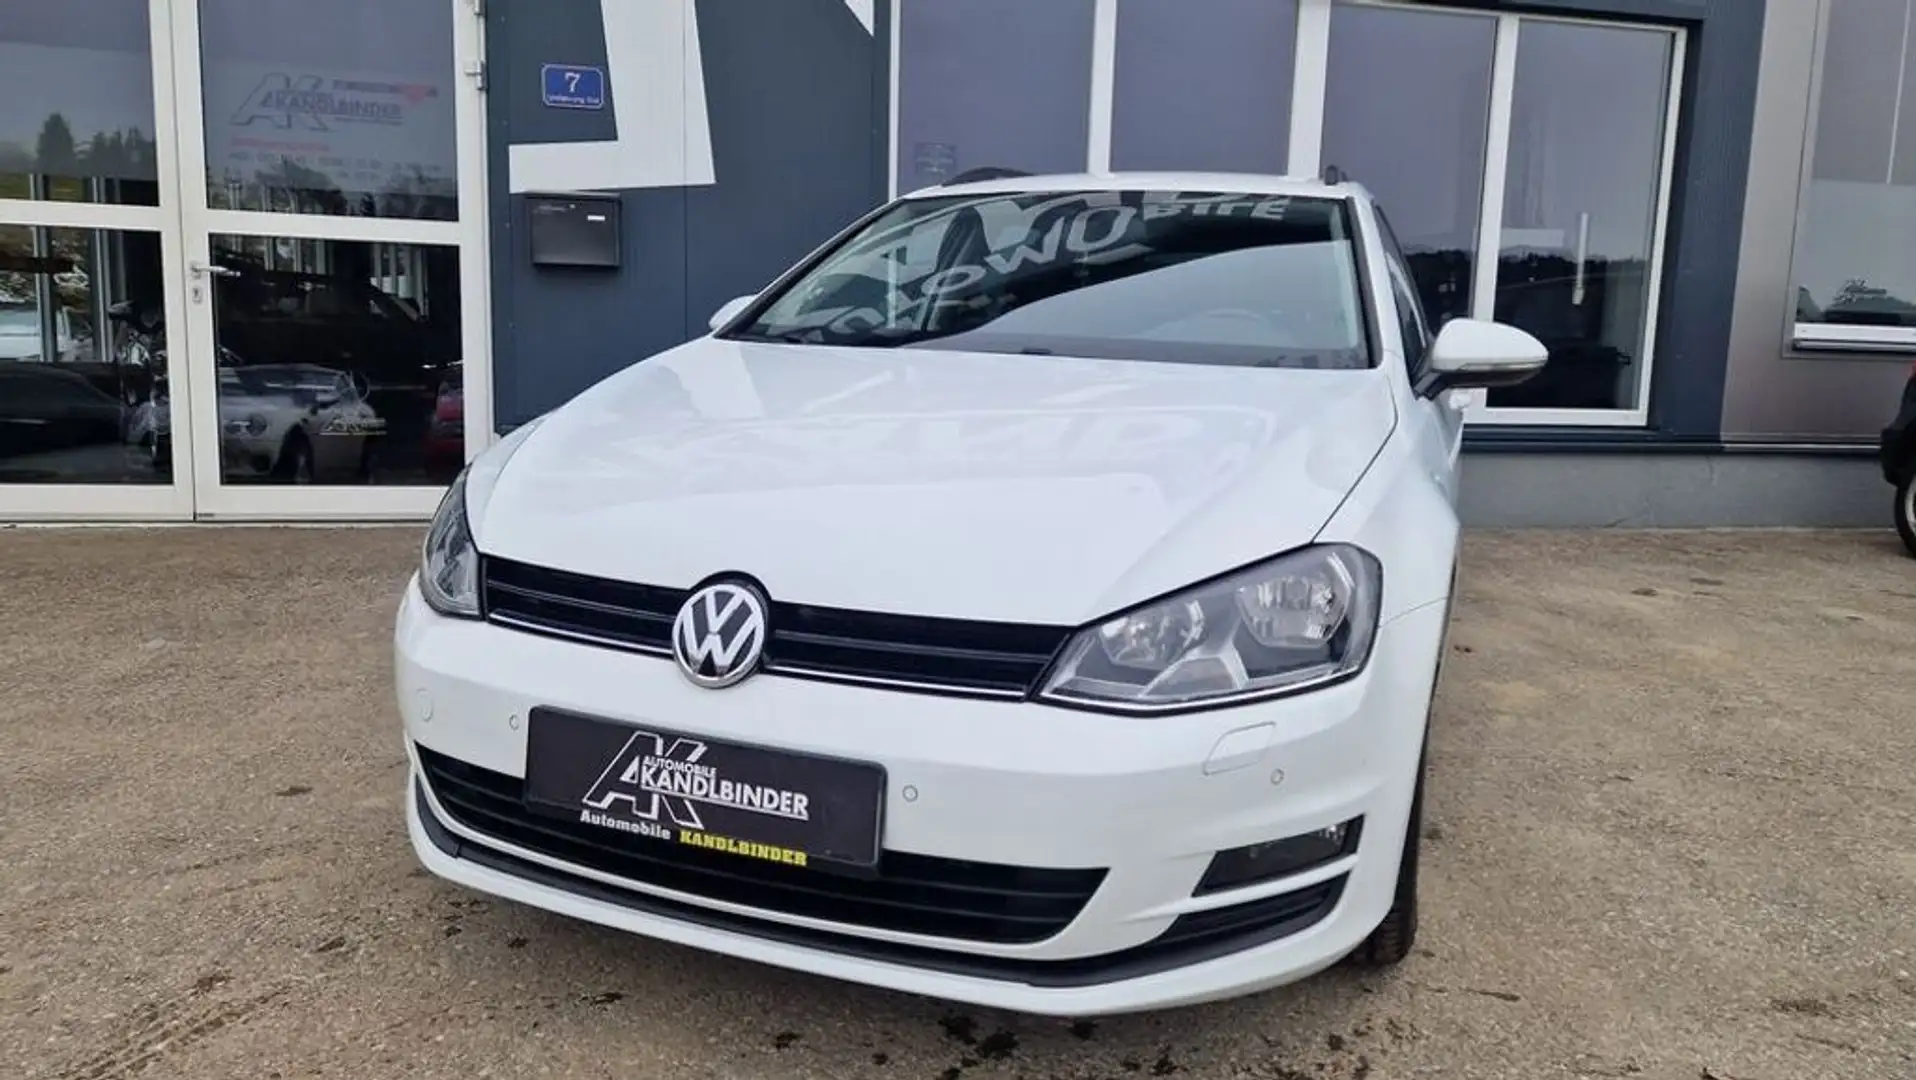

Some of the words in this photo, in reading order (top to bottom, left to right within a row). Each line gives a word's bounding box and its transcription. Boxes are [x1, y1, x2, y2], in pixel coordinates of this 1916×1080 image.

[564, 71, 581, 93] 7
[675, 585, 762, 681] VW
[641, 764, 809, 818] KANDLBINDER
[642, 755, 716, 779] AUTOMOBILE
[580, 809, 671, 840] Automobile
[679, 829, 807, 867] KANDLBINDER
